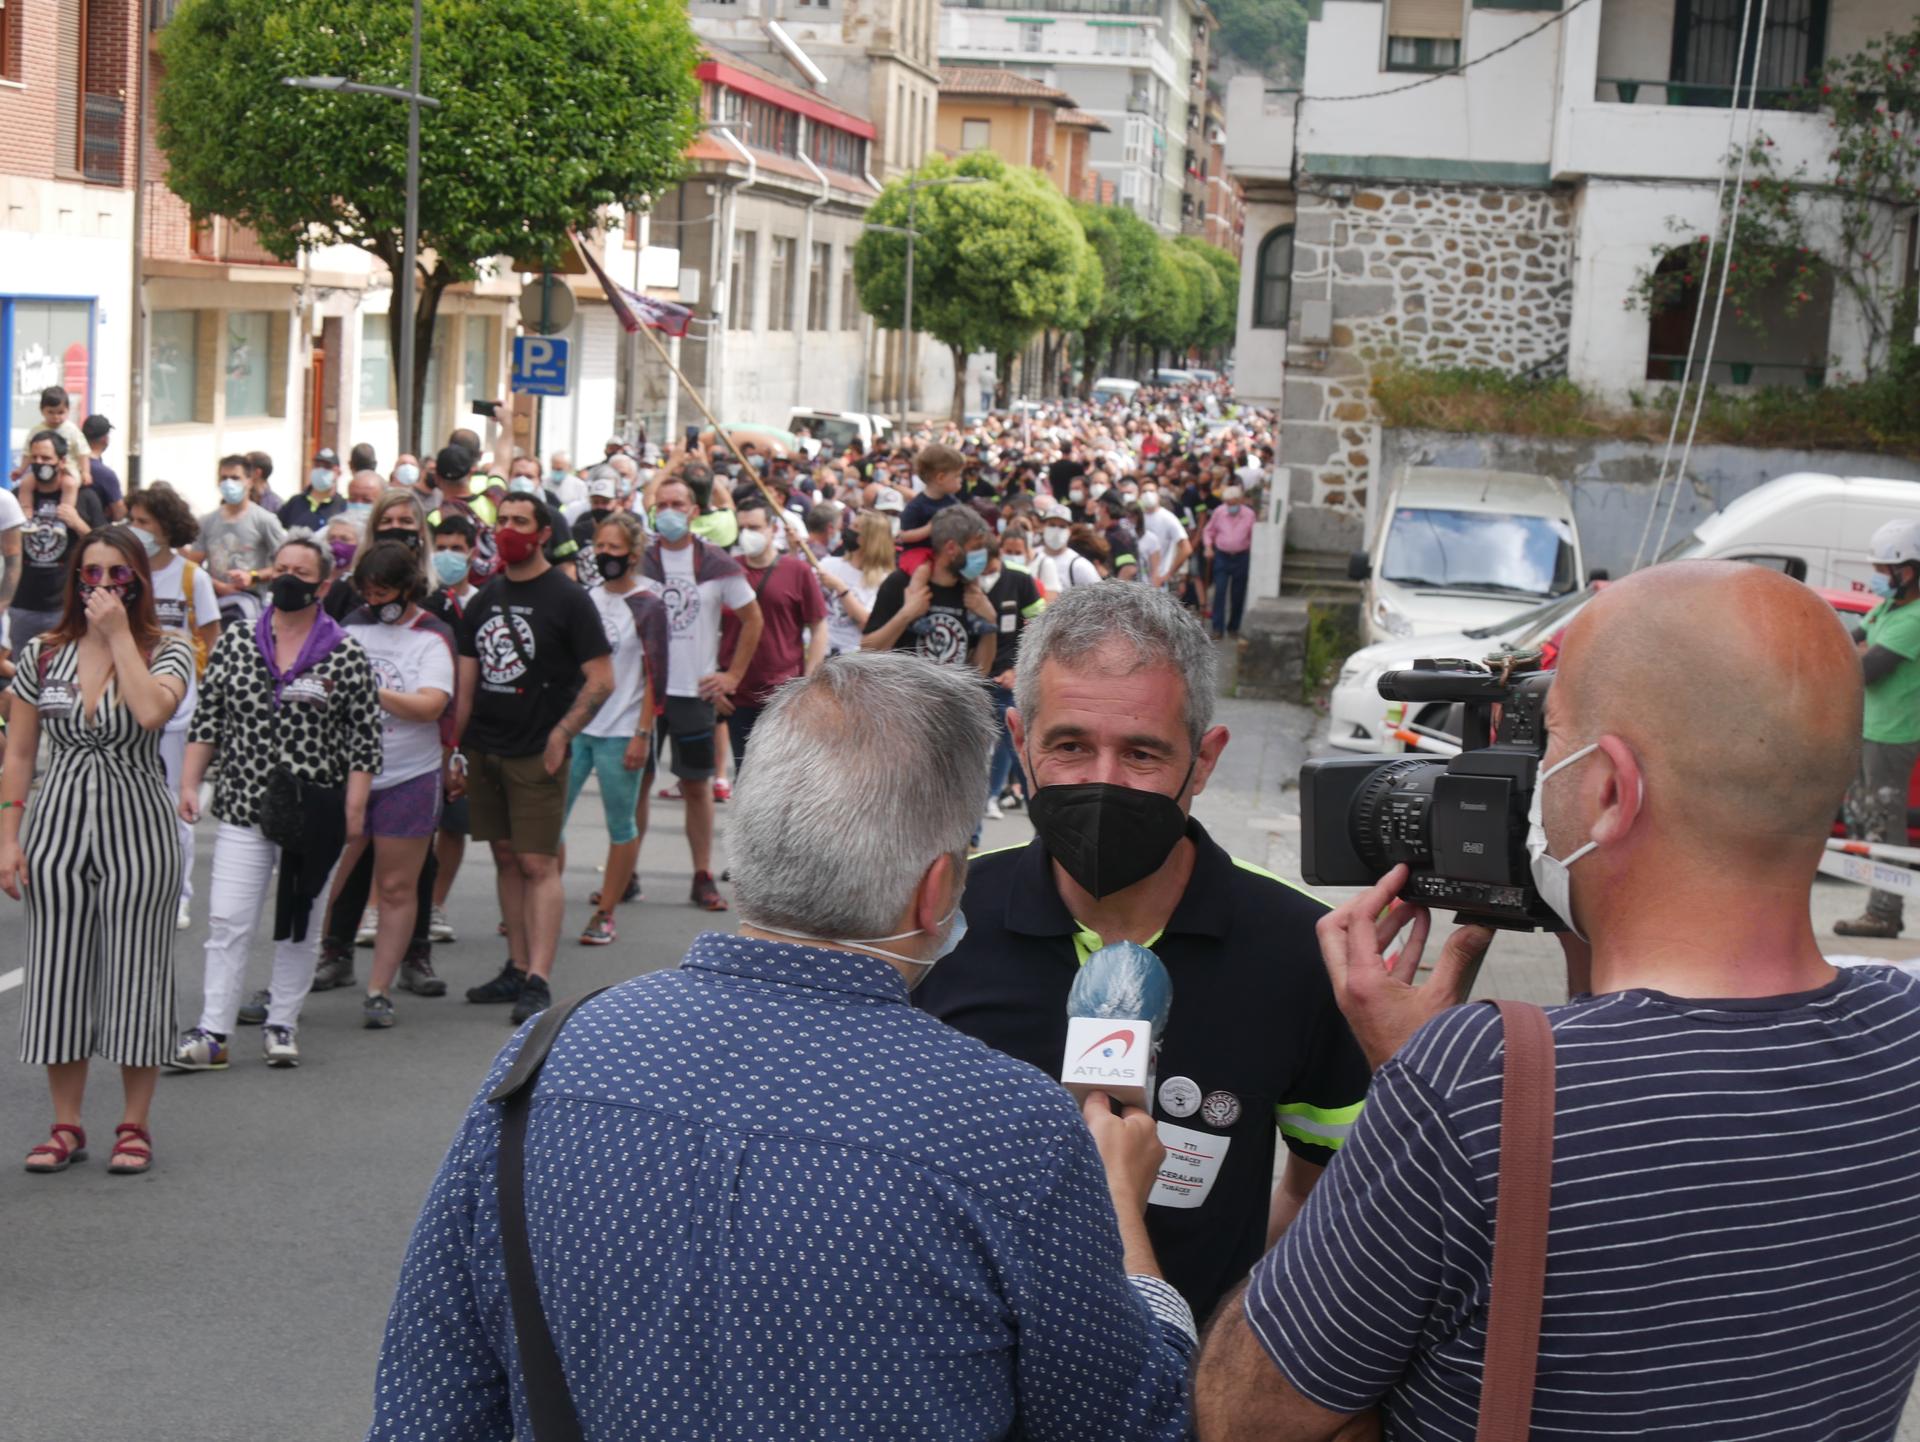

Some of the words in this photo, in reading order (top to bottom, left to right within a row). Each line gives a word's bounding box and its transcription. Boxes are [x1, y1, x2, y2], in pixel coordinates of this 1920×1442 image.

[522, 339, 553, 377] P
[1072, 1065, 1136, 1079] ATLAS
[1158, 1170, 1204, 1184] CERALAVA
